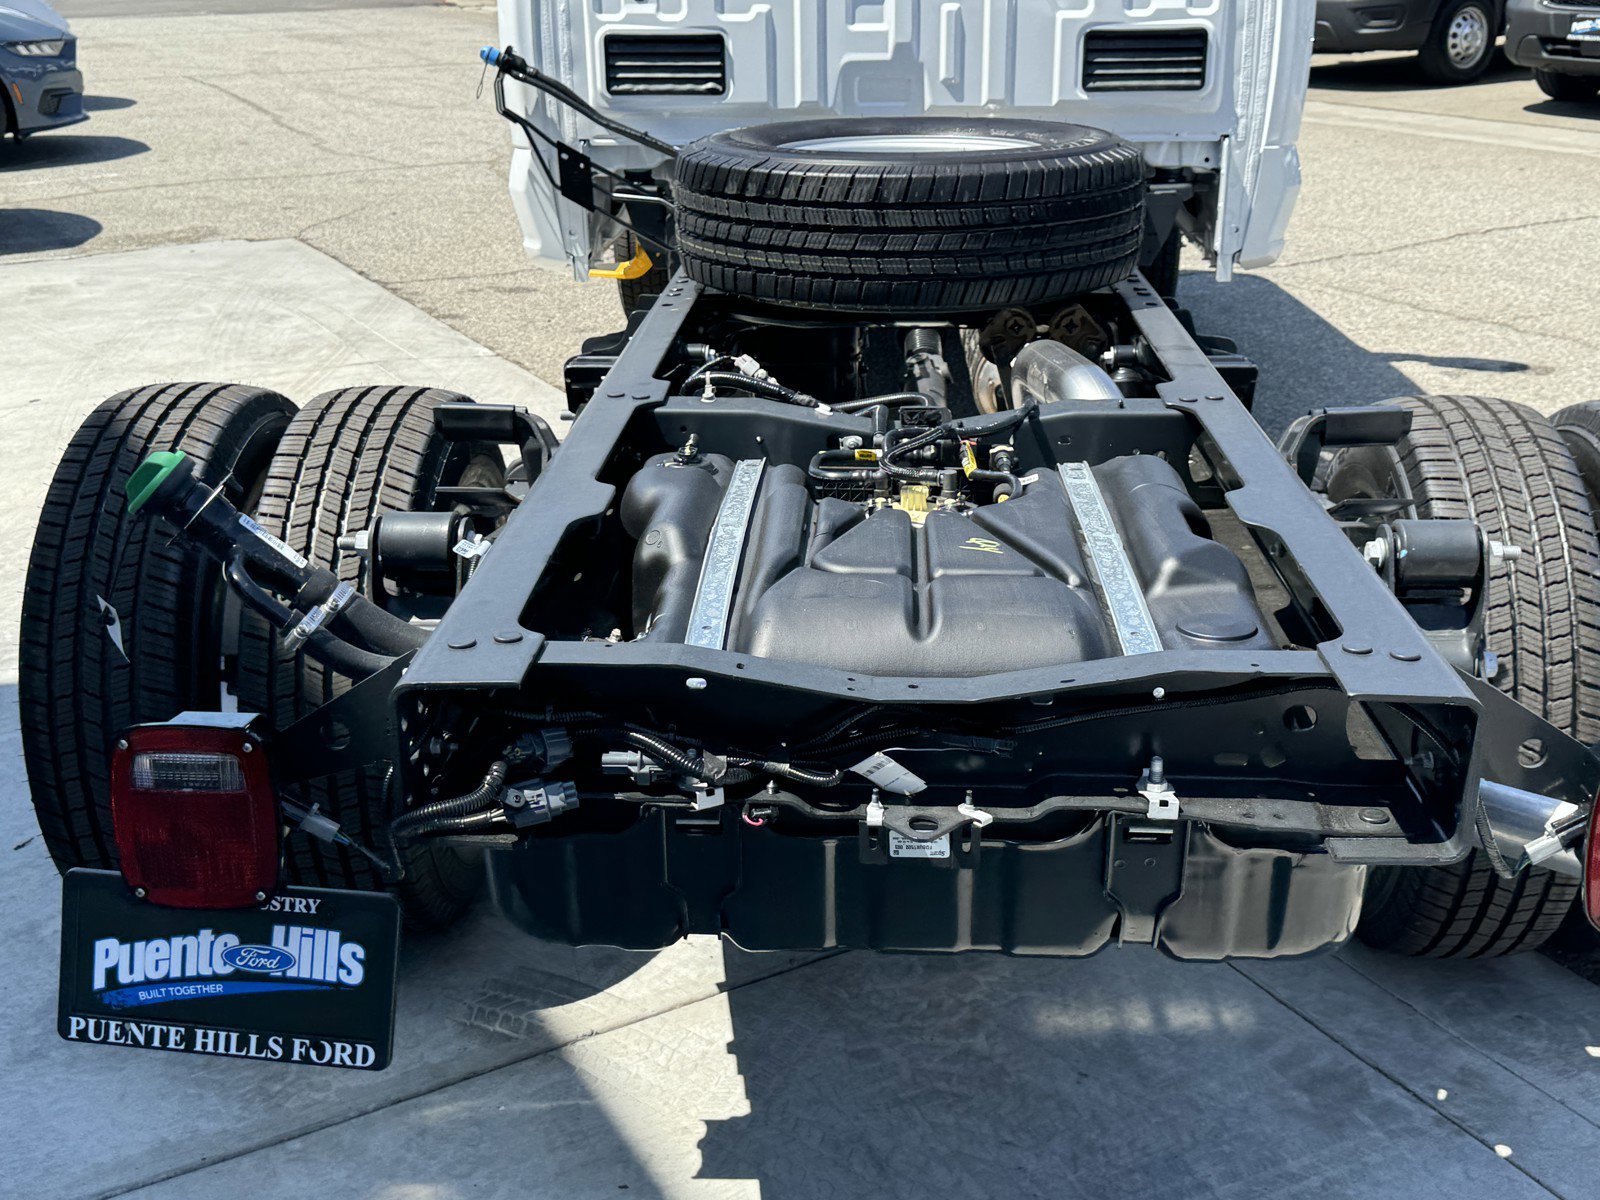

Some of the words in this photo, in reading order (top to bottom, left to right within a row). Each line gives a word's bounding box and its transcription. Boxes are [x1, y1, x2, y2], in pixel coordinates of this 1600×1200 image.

[261, 895, 321, 914] STRY
[93, 928, 240, 991] Puente
[270, 924, 365, 986] Hills
[236, 947, 281, 969] Ford
[138, 986, 167, 1001] BUILT
[168, 983, 223, 997] TOGETHER
[67, 1015, 186, 1050] PUENTE
[193, 1028, 283, 1060] HILLS
[291, 1038, 376, 1068] FORD
